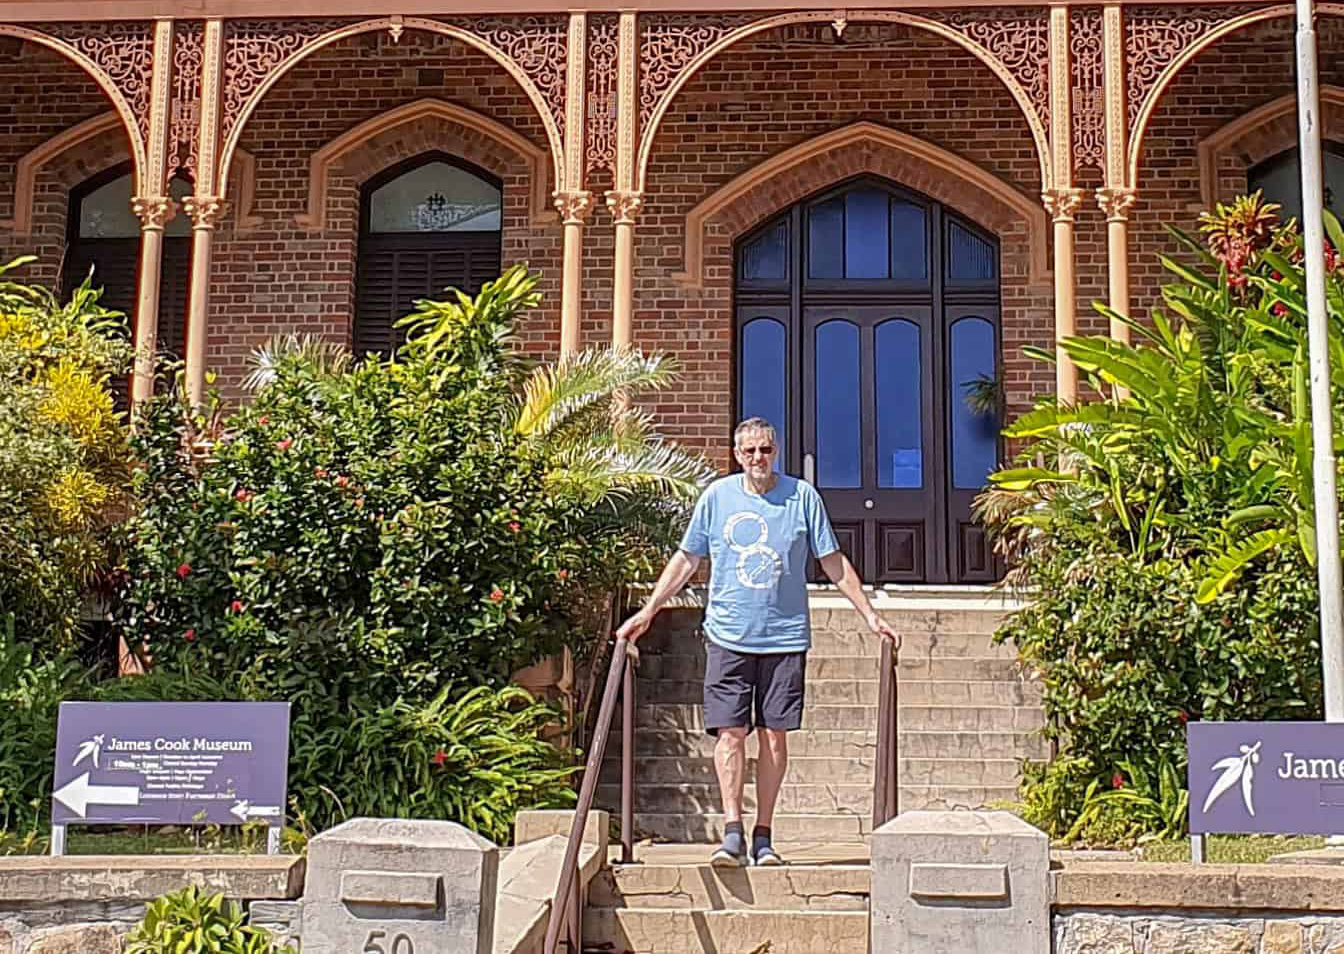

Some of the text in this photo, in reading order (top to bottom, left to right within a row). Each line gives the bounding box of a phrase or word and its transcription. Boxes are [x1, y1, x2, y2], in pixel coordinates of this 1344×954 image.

[107, 738, 253, 751] James Cook Museum
[363, 930, 415, 954] 50
